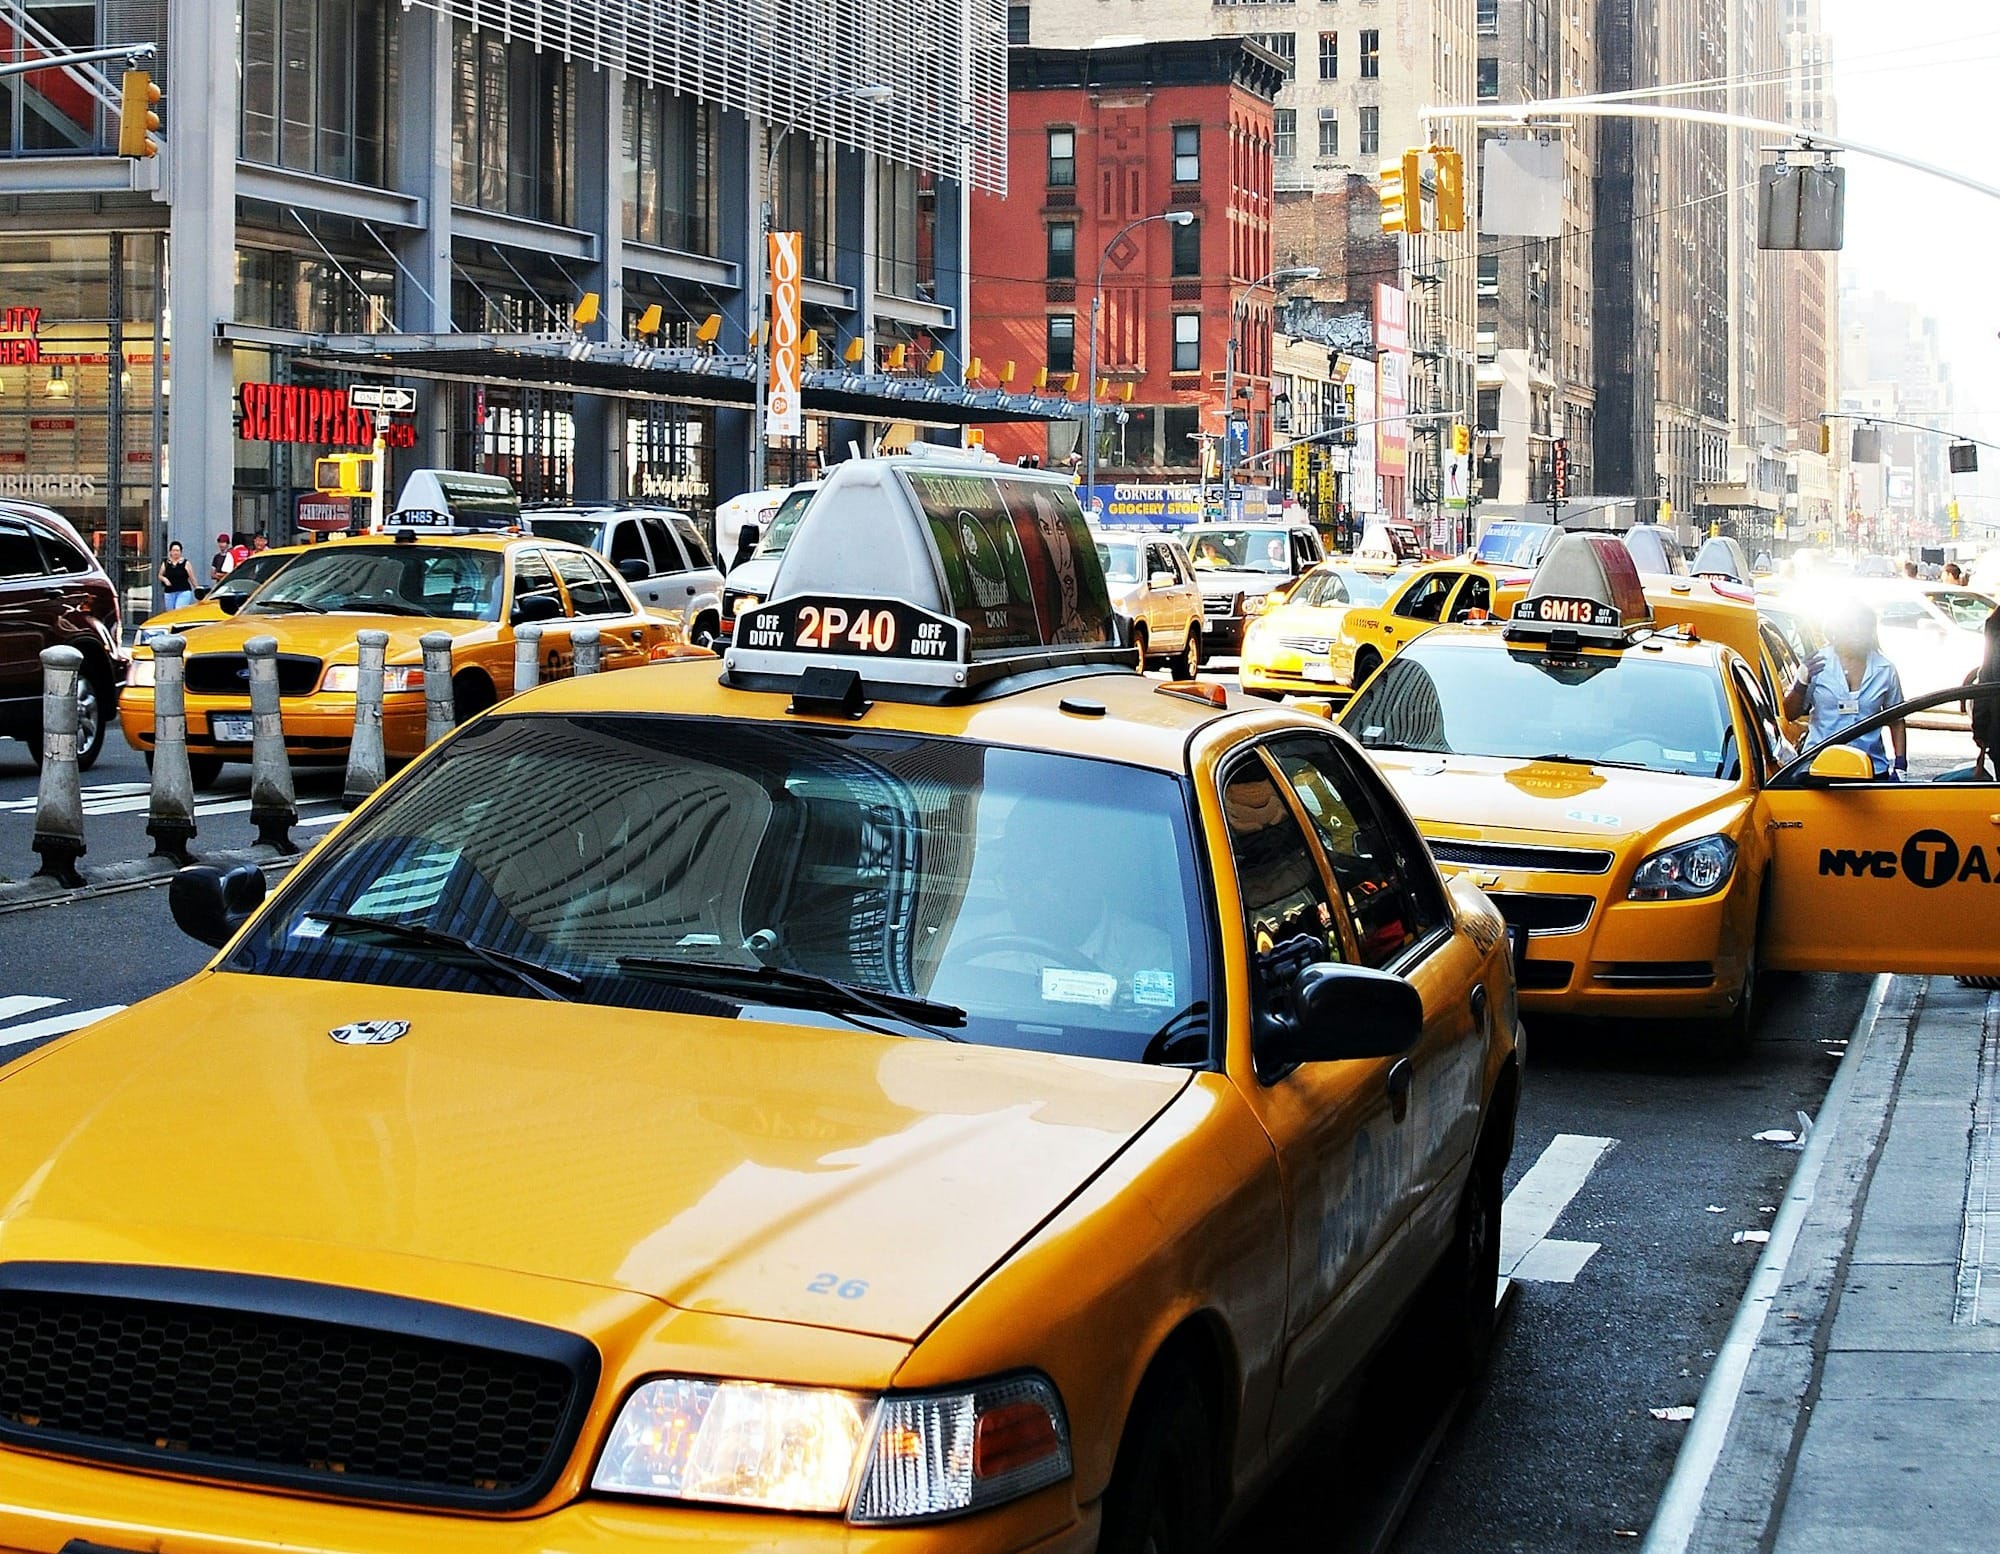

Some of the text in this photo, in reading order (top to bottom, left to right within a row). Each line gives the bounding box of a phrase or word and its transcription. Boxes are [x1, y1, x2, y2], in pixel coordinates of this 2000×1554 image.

[0, 306, 41, 332] ITY
[360, 394, 404, 404] ONE WAY
[0, 474, 95, 497] BURGERS
[1114, 488, 1163, 501] CORNER
[1108, 503, 1164, 515] GROCERY
[1167, 503, 1200, 515] STOR
[405, 511, 433, 524] 1H85
[1518, 610, 1535, 619] DUTY
[1521, 603, 1533, 611] OFF
[1540, 599, 1592, 623] 6M13
[1598, 608, 1610, 616] OFF
[756, 614, 779, 630] OFF
[1595, 616, 1612, 625] DUTY
[796, 606, 896, 652] 2P40
[918, 623, 942, 639] OFF
[750, 630, 784, 647] DUTY
[911, 639, 947, 656] DUTY
[1818, 838, 2000, 884] NYC TA
[806, 1273, 870, 1300] 26
